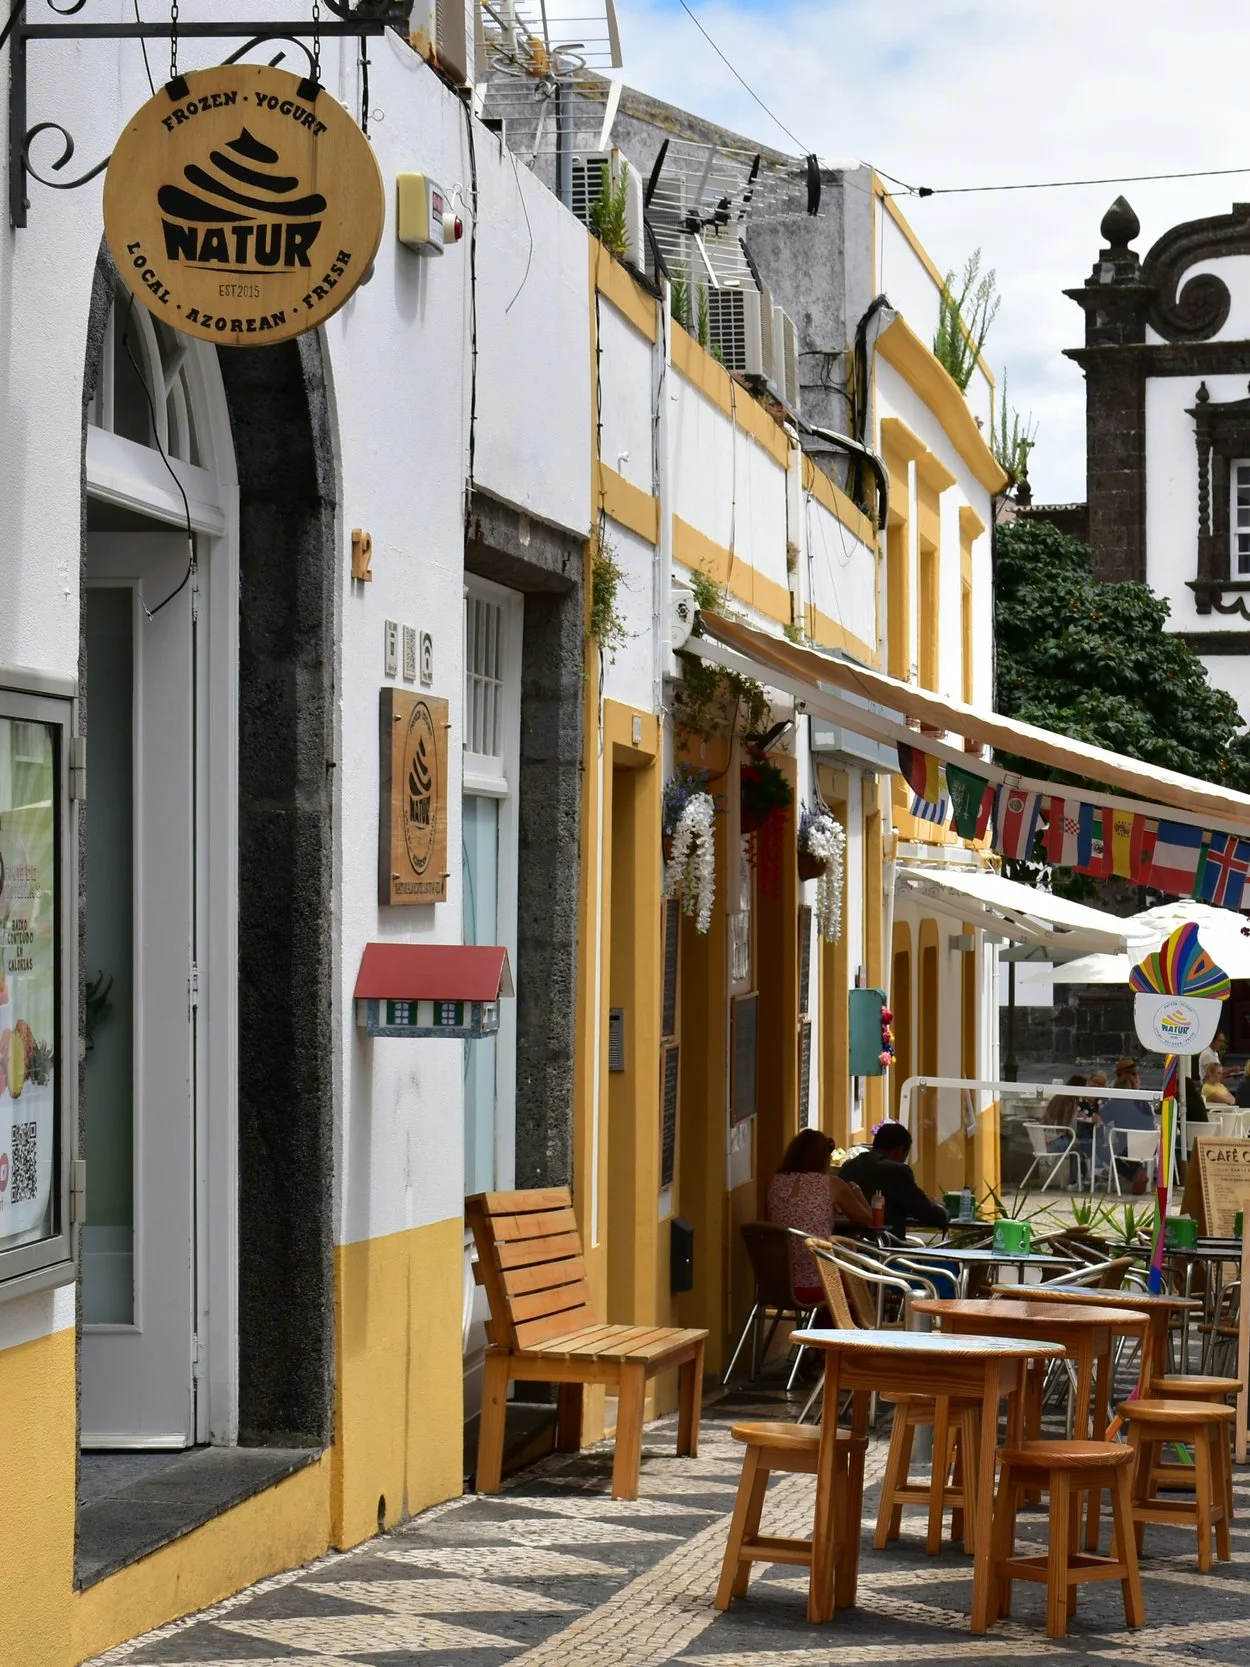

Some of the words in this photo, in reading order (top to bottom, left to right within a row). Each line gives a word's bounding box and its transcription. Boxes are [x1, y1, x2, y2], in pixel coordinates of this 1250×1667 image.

[161, 91, 238, 132] FROZEN
[255, 92, 328, 137] YOGURT
[161, 217, 323, 268] NATUR
[127, 241, 170, 305] LOCAL
[185, 307, 288, 333] AZOREAN
[302, 249, 352, 310] FRESH
[218, 284, 261, 299] EST2015
[351, 527, 373, 583] 12
[409, 794, 432, 826] NATUR
[12, 919, 28, 932] BAIXO
[1161, 1023, 1190, 1035] NATUR
